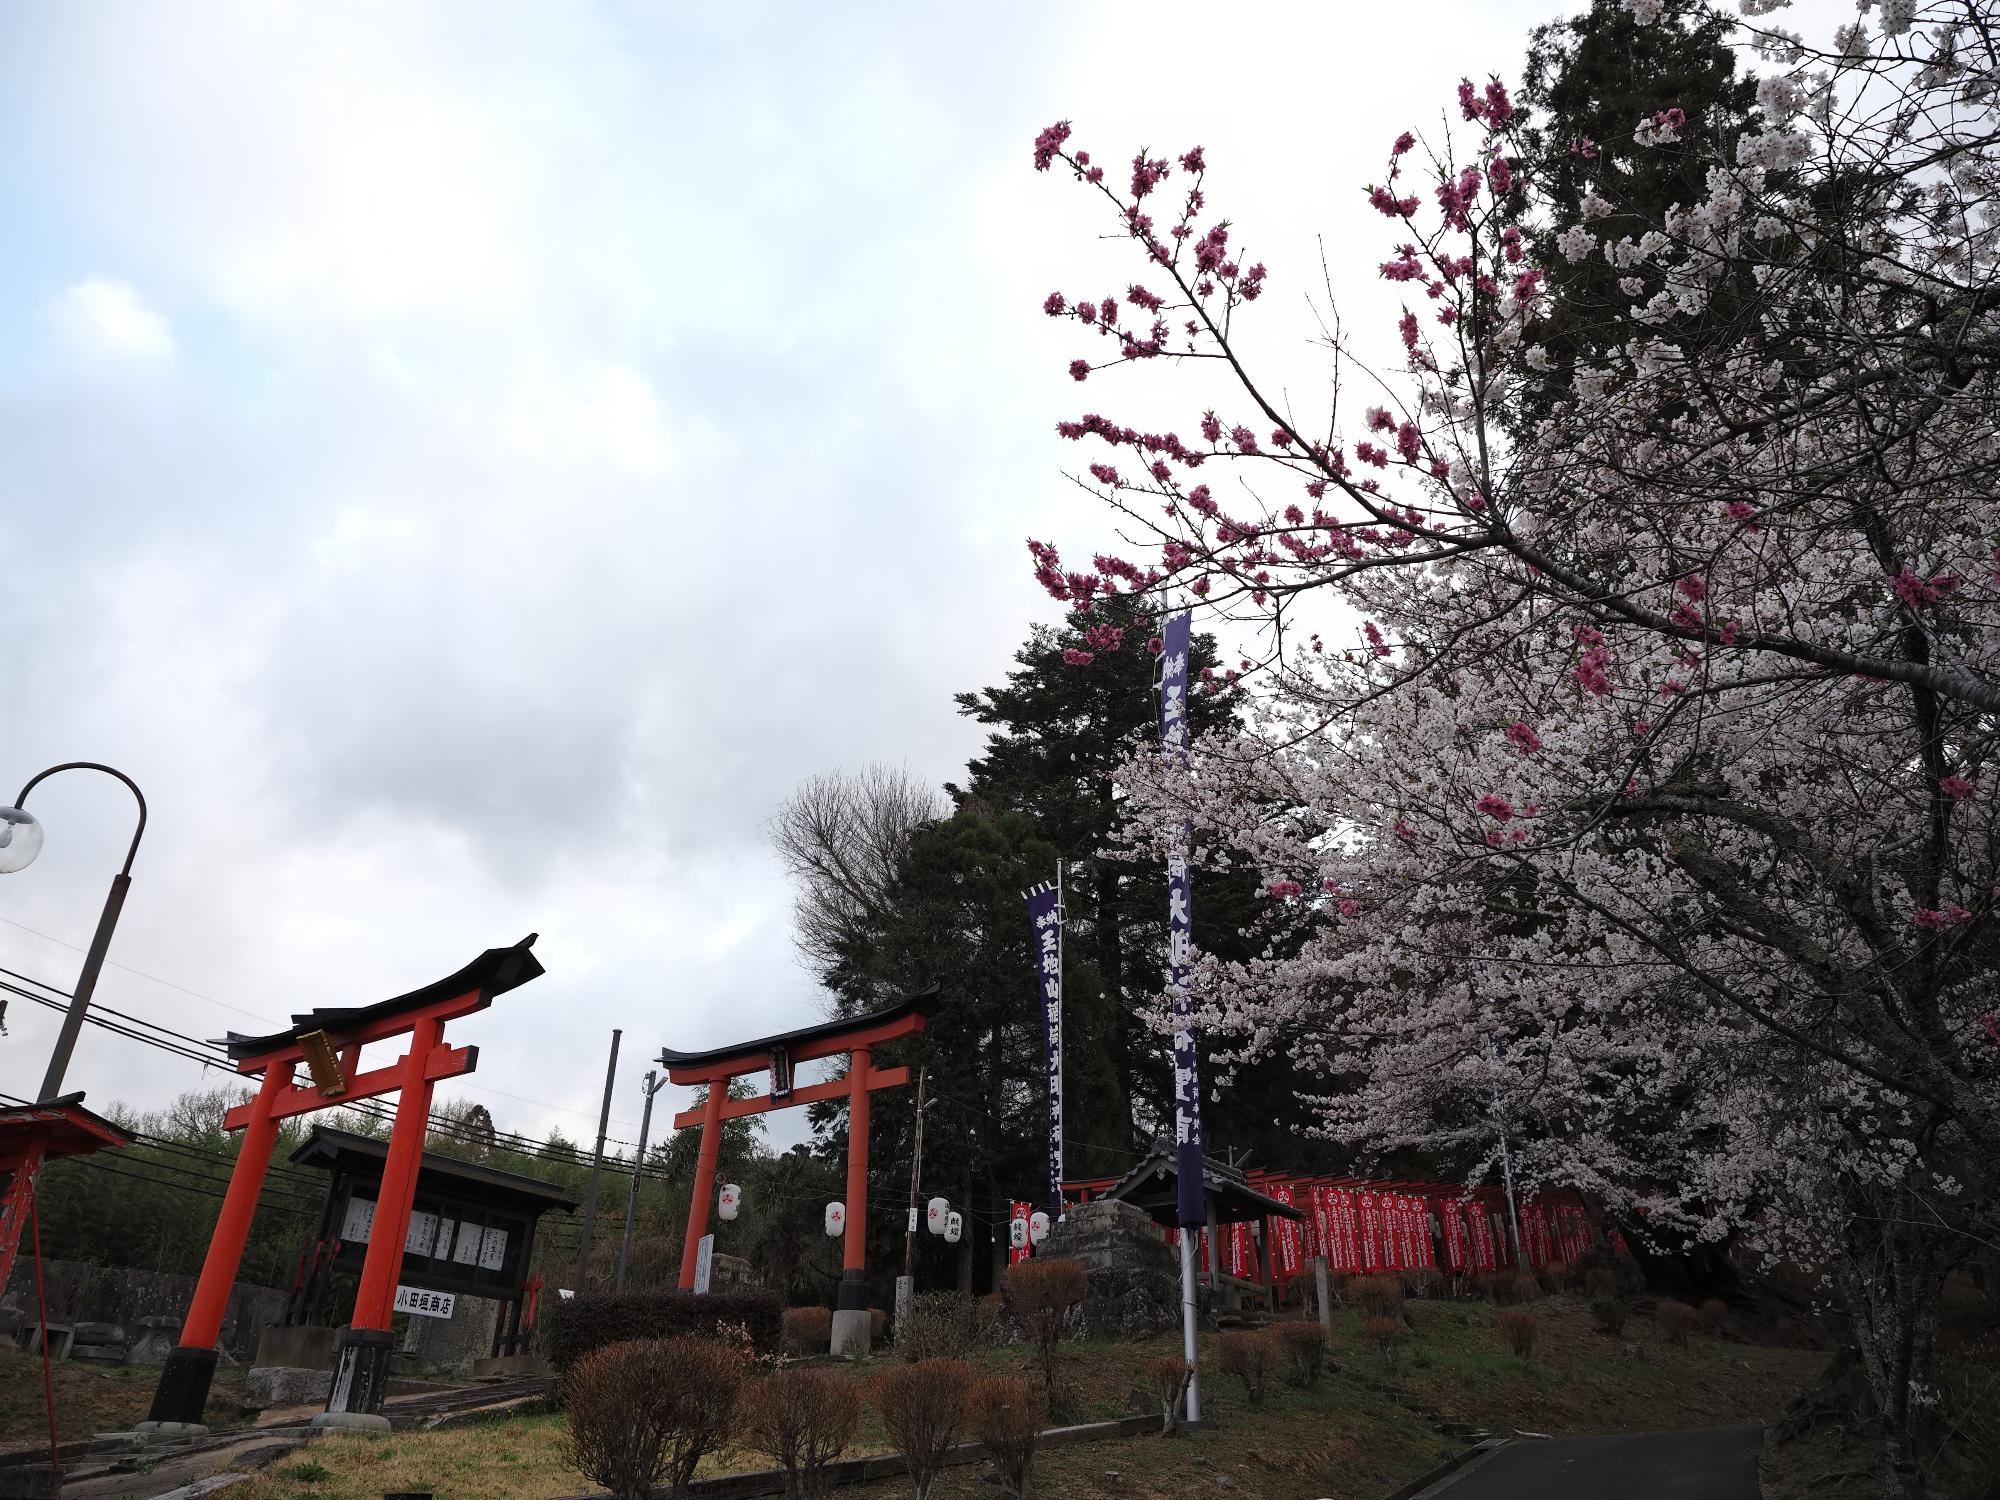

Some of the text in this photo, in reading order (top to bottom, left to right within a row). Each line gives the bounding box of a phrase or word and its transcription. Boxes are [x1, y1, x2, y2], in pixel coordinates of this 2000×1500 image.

[396, 1289, 451, 1314] 小田垣商店
